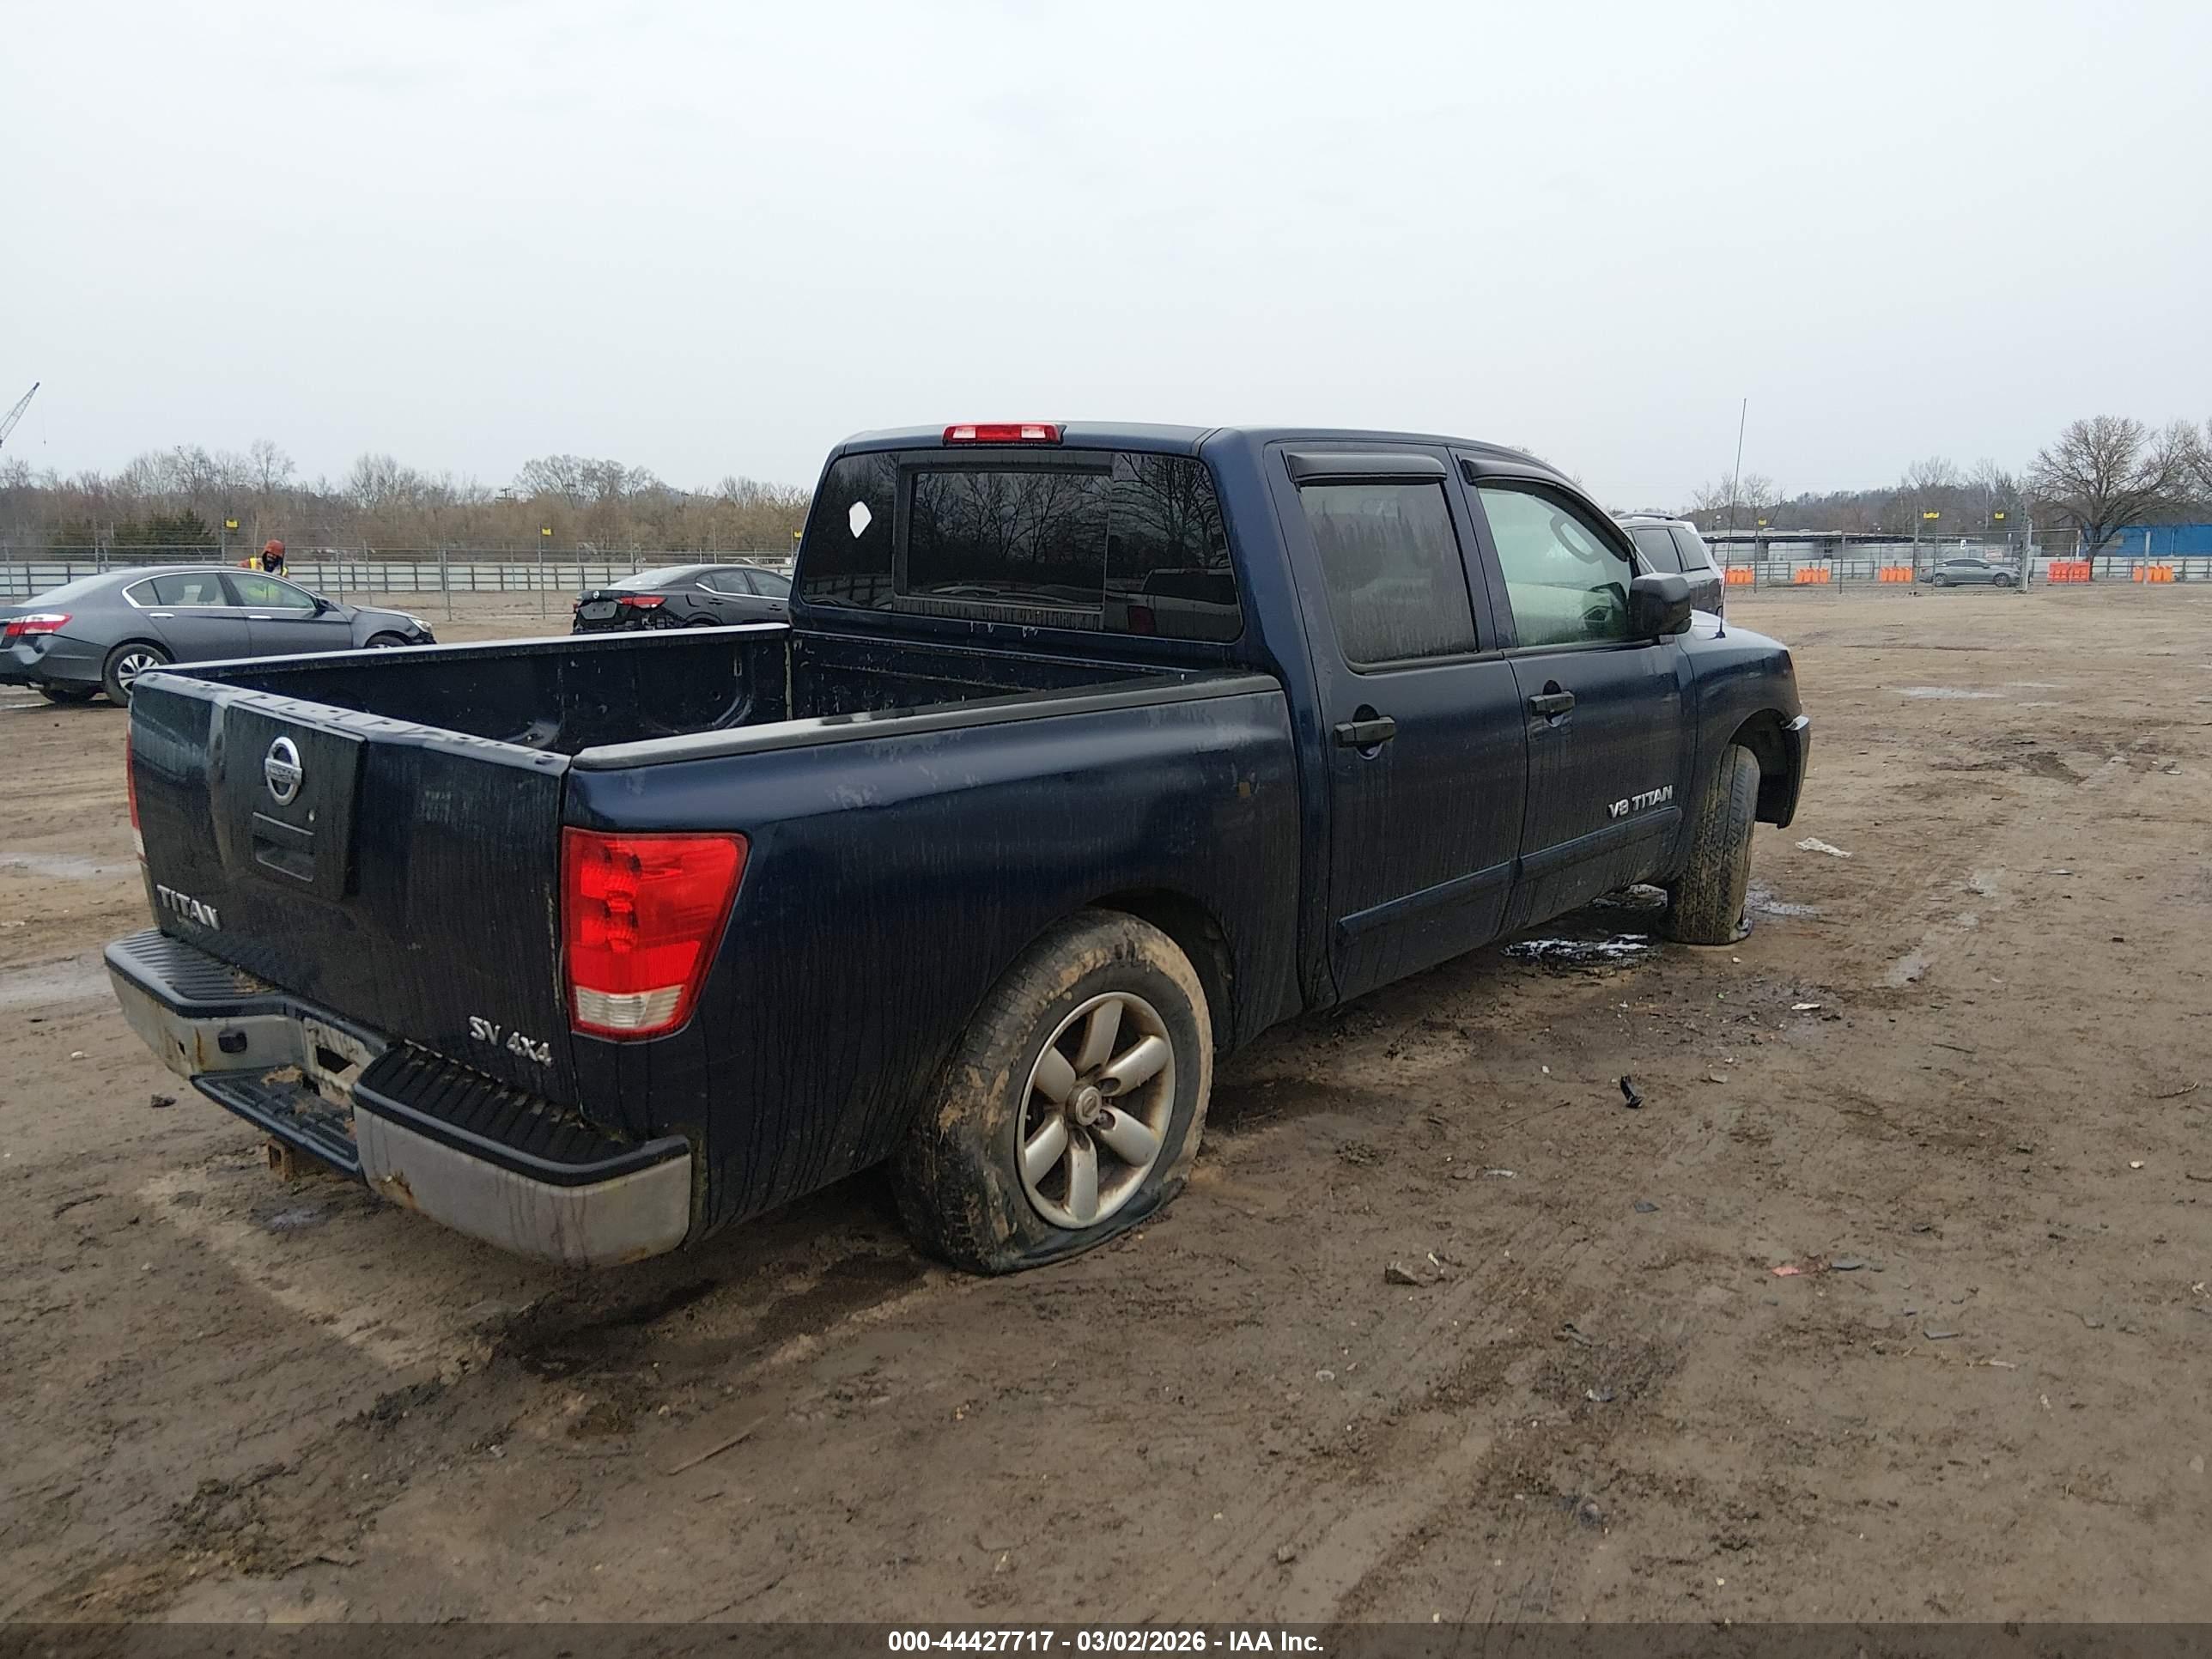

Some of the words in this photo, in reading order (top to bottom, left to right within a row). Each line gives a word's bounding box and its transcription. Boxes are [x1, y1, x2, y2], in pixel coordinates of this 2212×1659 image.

[1608, 799, 1629, 818] V8
[1632, 785, 1673, 811] TITAN
[156, 884, 220, 930] TITAN
[469, 1016, 501, 1046] SV
